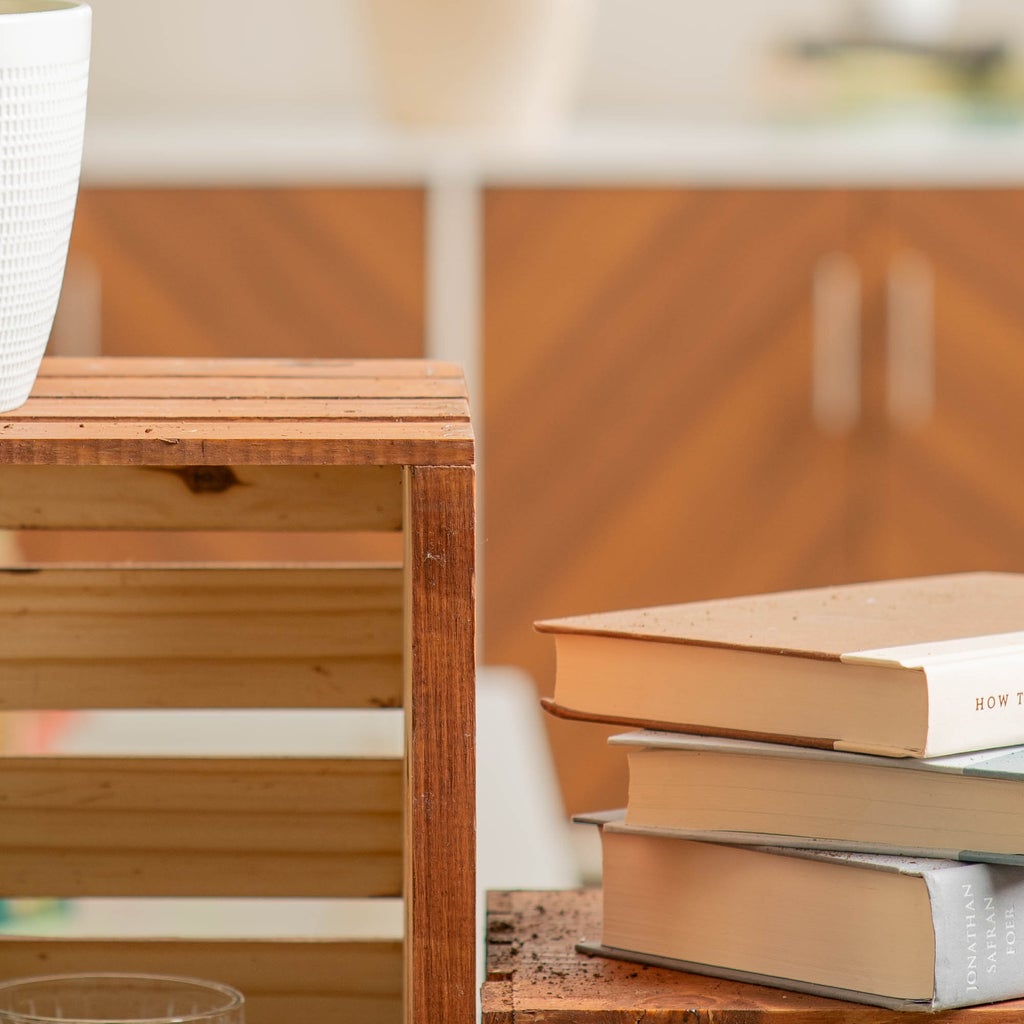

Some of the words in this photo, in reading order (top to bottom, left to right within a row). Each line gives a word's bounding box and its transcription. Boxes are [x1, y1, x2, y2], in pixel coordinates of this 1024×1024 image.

[975, 693, 1009, 711] HOW
[961, 884, 979, 991] JONATHAN
[984, 897, 997, 974] SAFRAN
[1005, 904, 1016, 955] FOER
